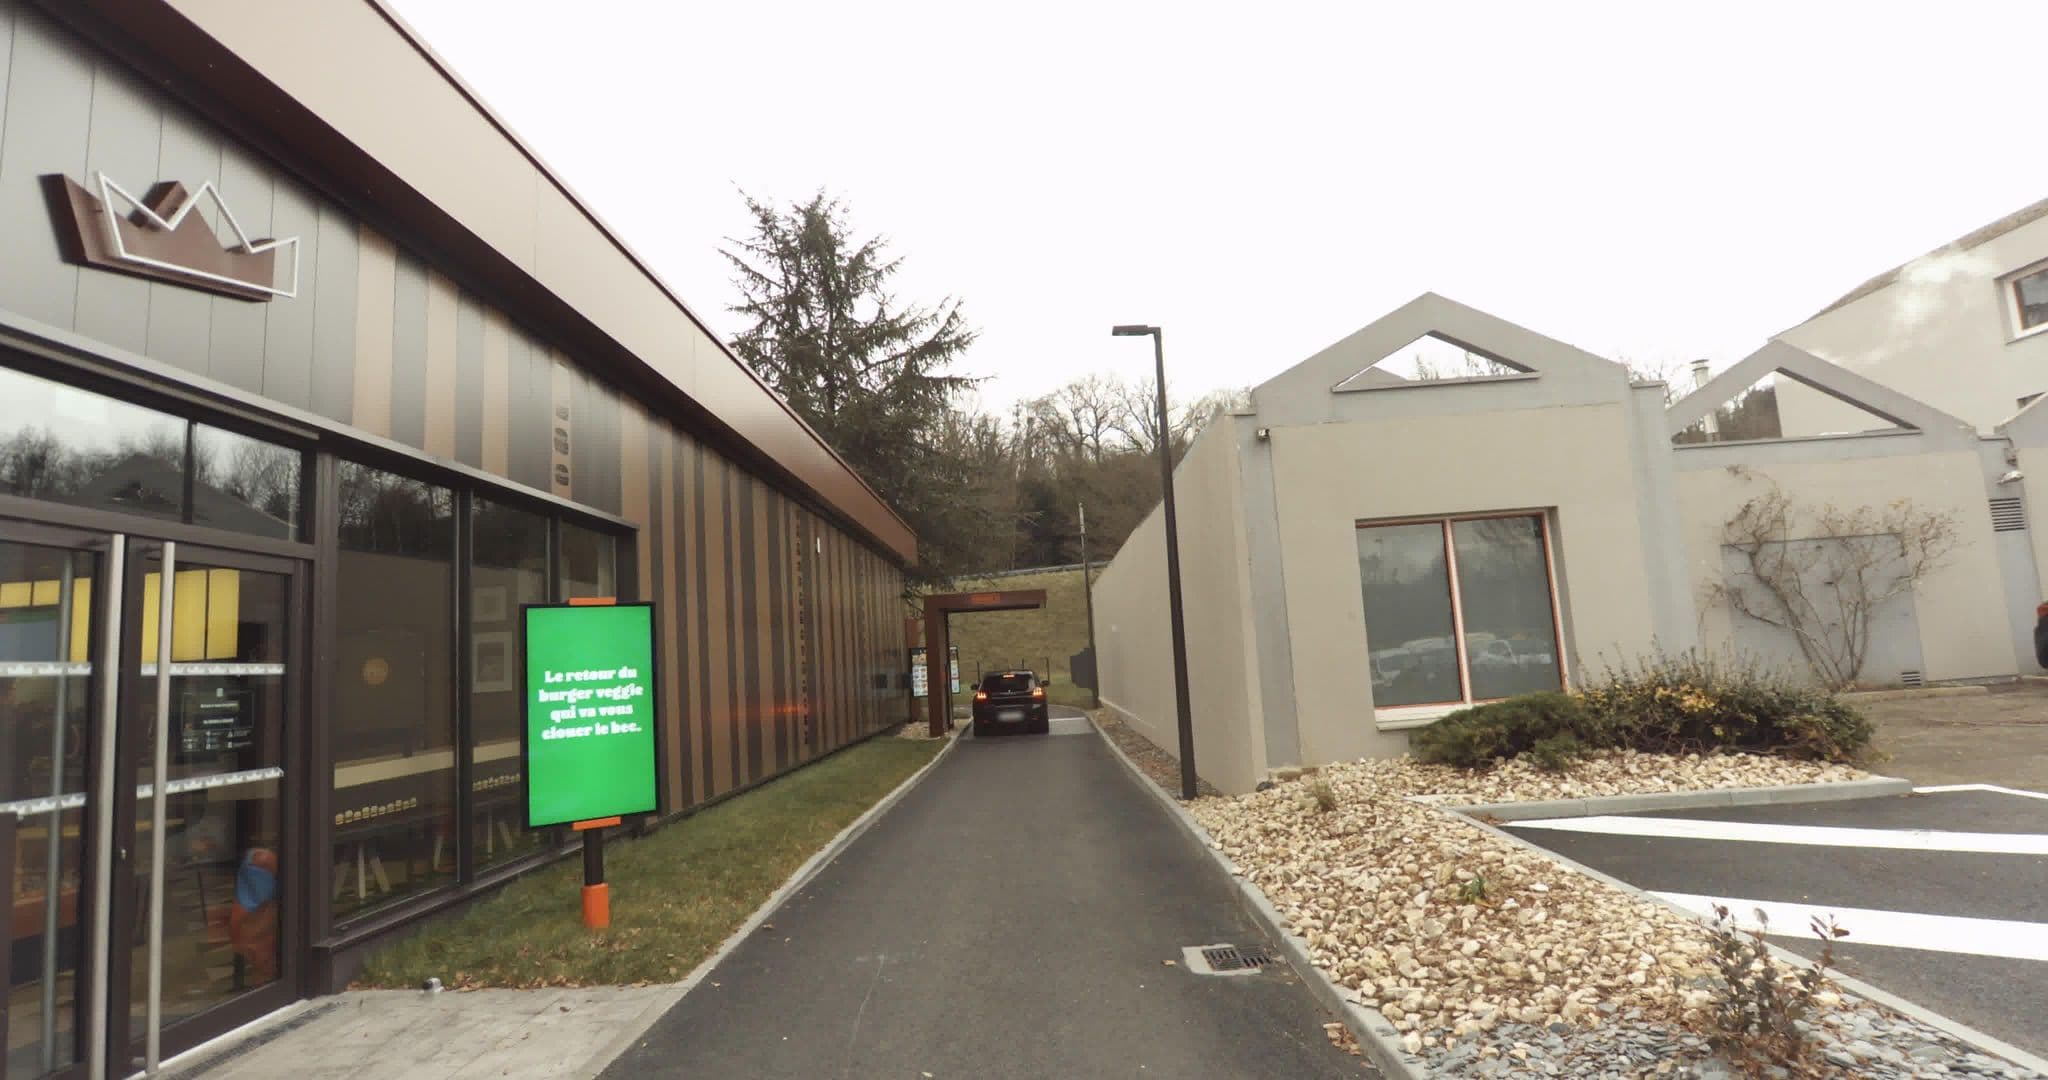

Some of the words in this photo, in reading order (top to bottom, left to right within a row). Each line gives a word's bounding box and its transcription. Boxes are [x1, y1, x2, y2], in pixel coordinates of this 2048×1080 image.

[545, 671, 563, 682] Le
[566, 670, 616, 681] retour
[618, 666, 637, 679] du
[539, 688, 593, 703] burger
[596, 683, 643, 700] veggie
[551, 705, 576, 722] qui
[578, 708, 597, 718] va
[599, 705, 634, 716] vous
[542, 726, 593, 740] clouer
[595, 722, 609, 735] le
[611, 721, 642, 734] bec.
